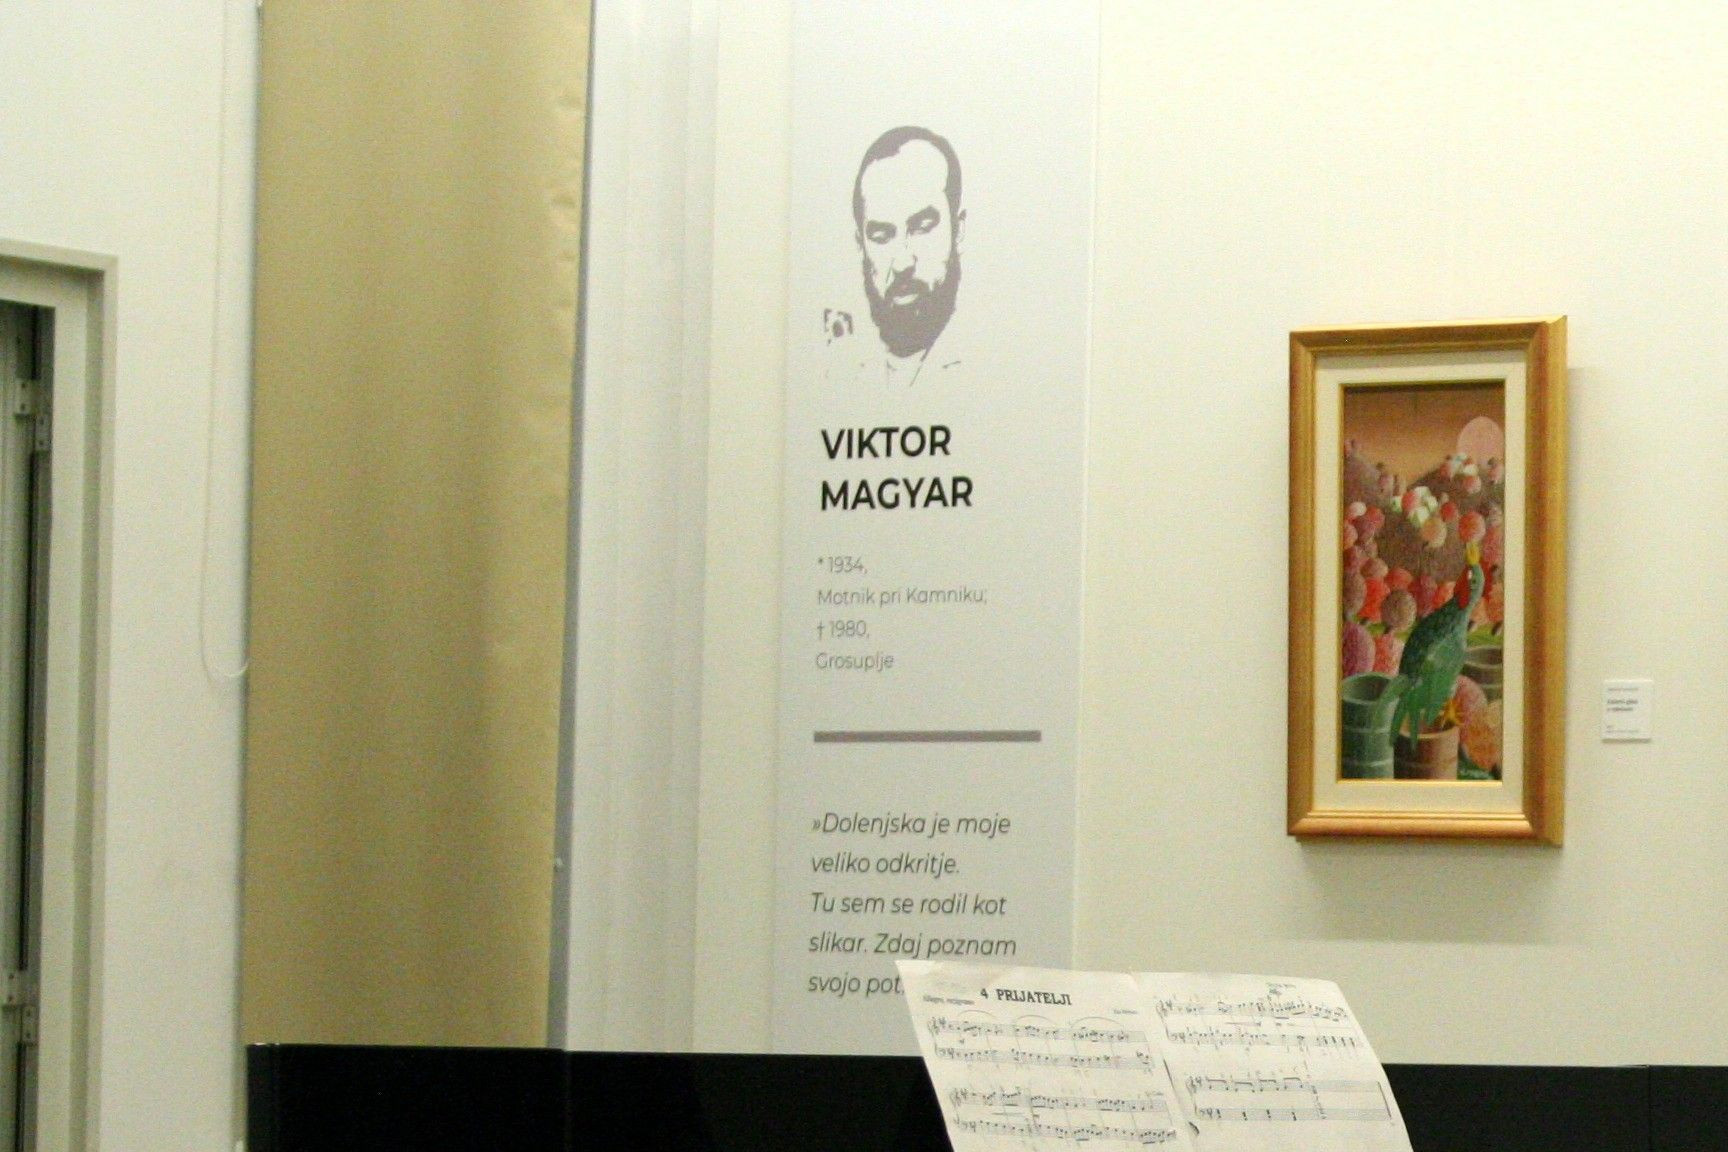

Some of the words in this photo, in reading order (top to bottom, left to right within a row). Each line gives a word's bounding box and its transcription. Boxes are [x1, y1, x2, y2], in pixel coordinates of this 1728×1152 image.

[820, 425, 952, 459] VIKTOR
[821, 476, 974, 511] MAGYAR
[817, 588, 876, 605] Motnik
[879, 587, 901, 608] pri
[815, 652, 894, 672] Grosuplje
[927, 812, 950, 838] je
[957, 812, 1011, 839] moje
[811, 852, 870, 874] veliko
[876, 853, 960, 879] odkritje.
[812, 892, 834, 913] Tu
[840, 896, 885, 913] sem
[891, 897, 914, 913] se
[920, 894, 968, 914] rodil
[973, 894, 1007, 915] kot
[808, 931, 867, 953] slikar.
[873, 933, 922, 958] Zdaj
[926, 940, 1017, 957] poznam
[808, 972, 861, 997] svojo
[980, 988, 989, 999] 4
[996, 988, 1072, 1005] PRIJATELJI
